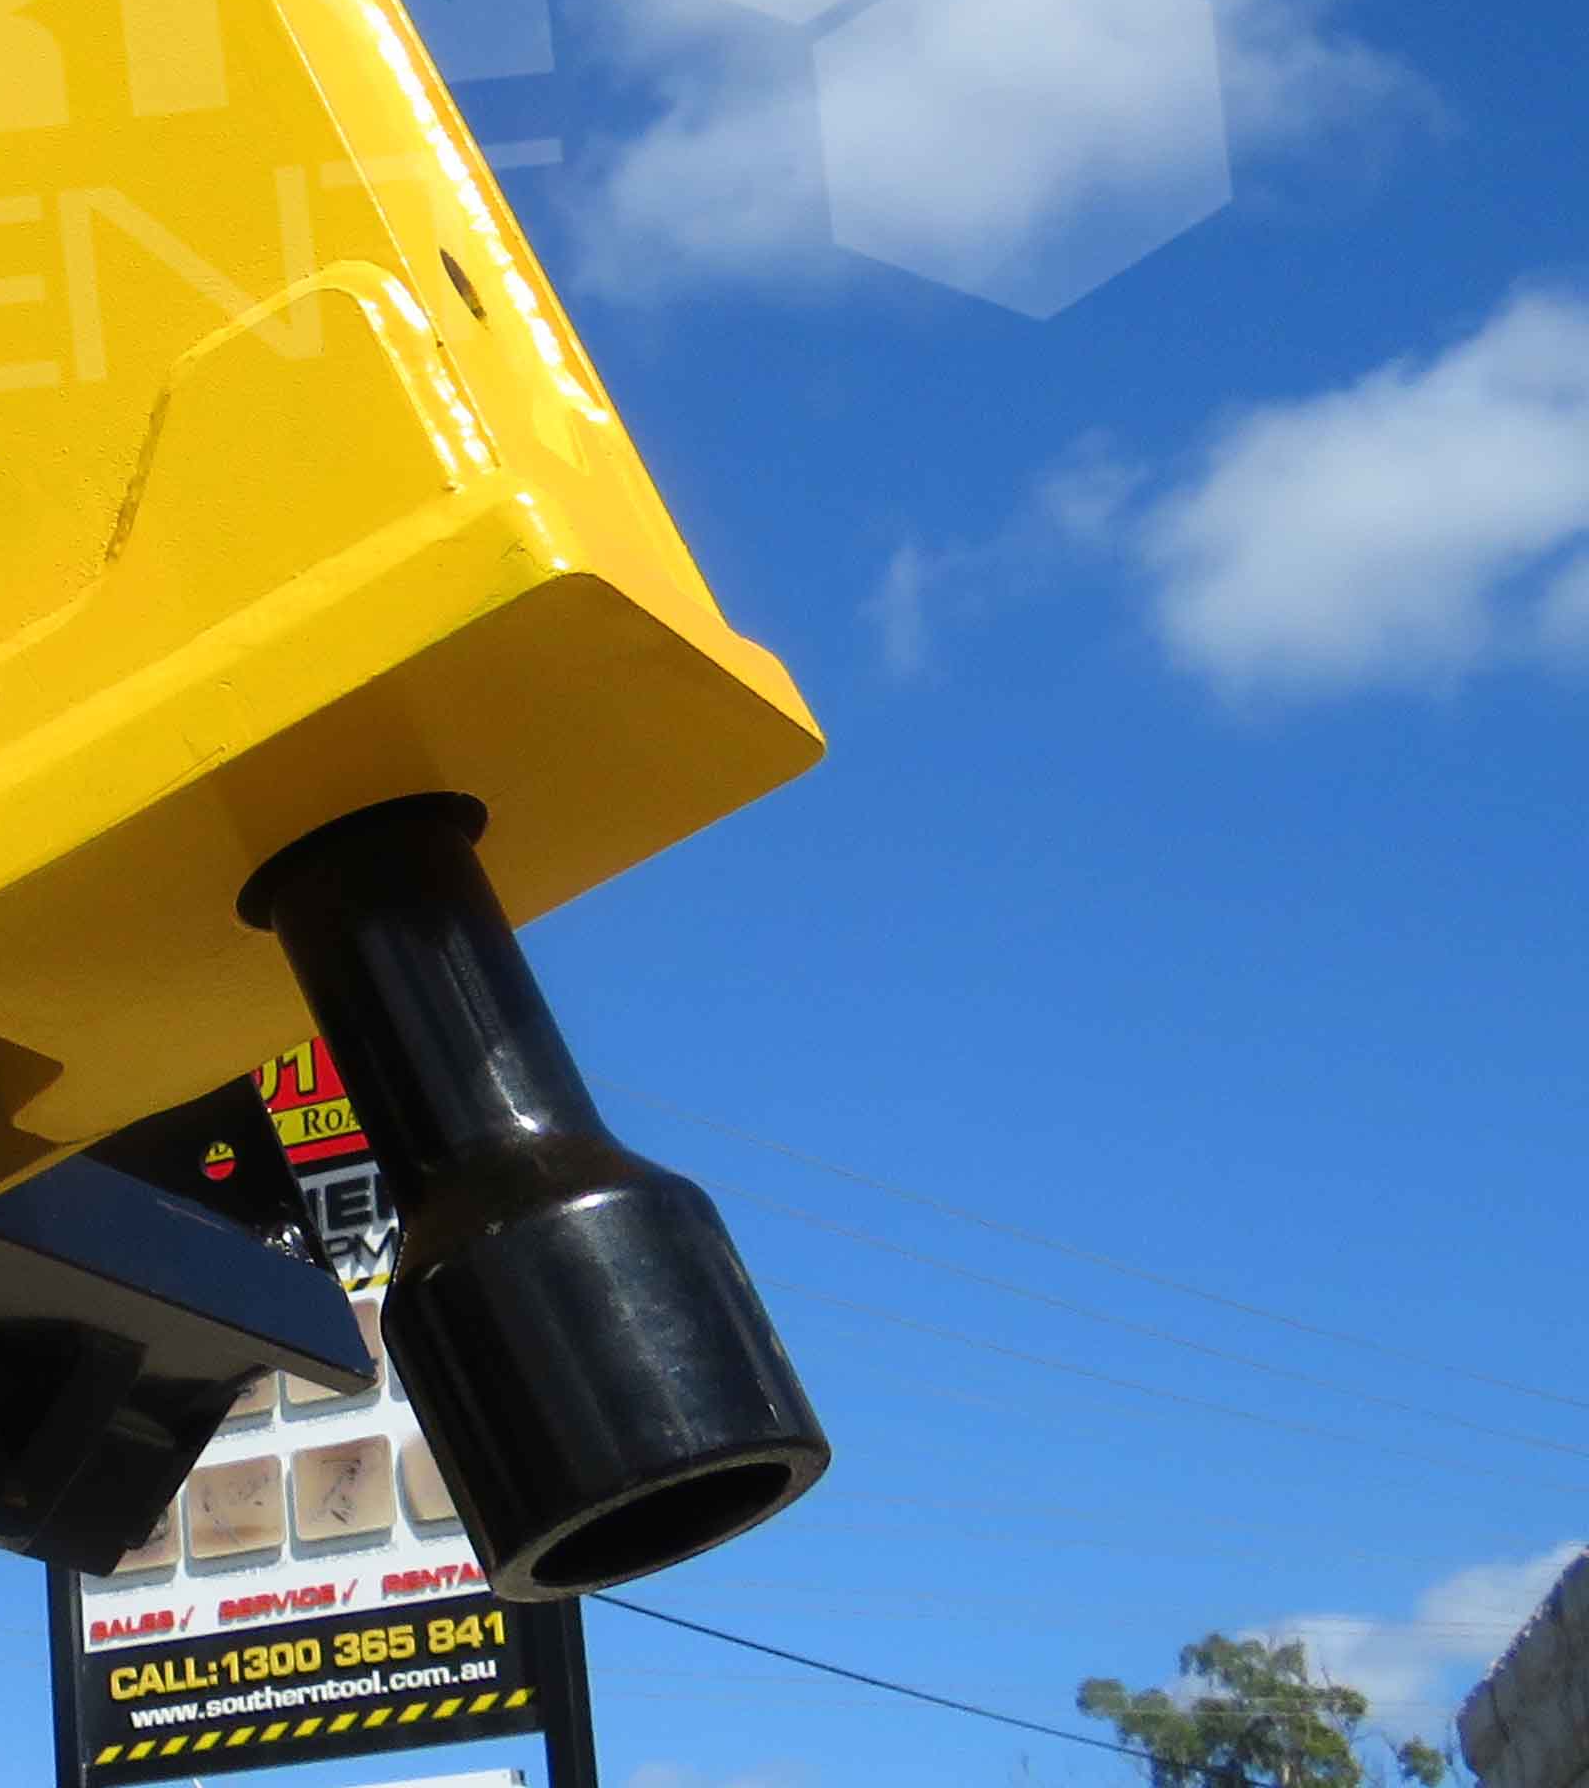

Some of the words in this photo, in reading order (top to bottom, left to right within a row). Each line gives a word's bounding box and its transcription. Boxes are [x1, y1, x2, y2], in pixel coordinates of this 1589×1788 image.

[90, 1610, 174, 1641] SALES
[219, 1583, 335, 1621] SERVICE
[333, 1624, 416, 1667] 365
[427, 1611, 505, 1654] 841
[131, 1660, 497, 1729] www.southerntool.com.au
